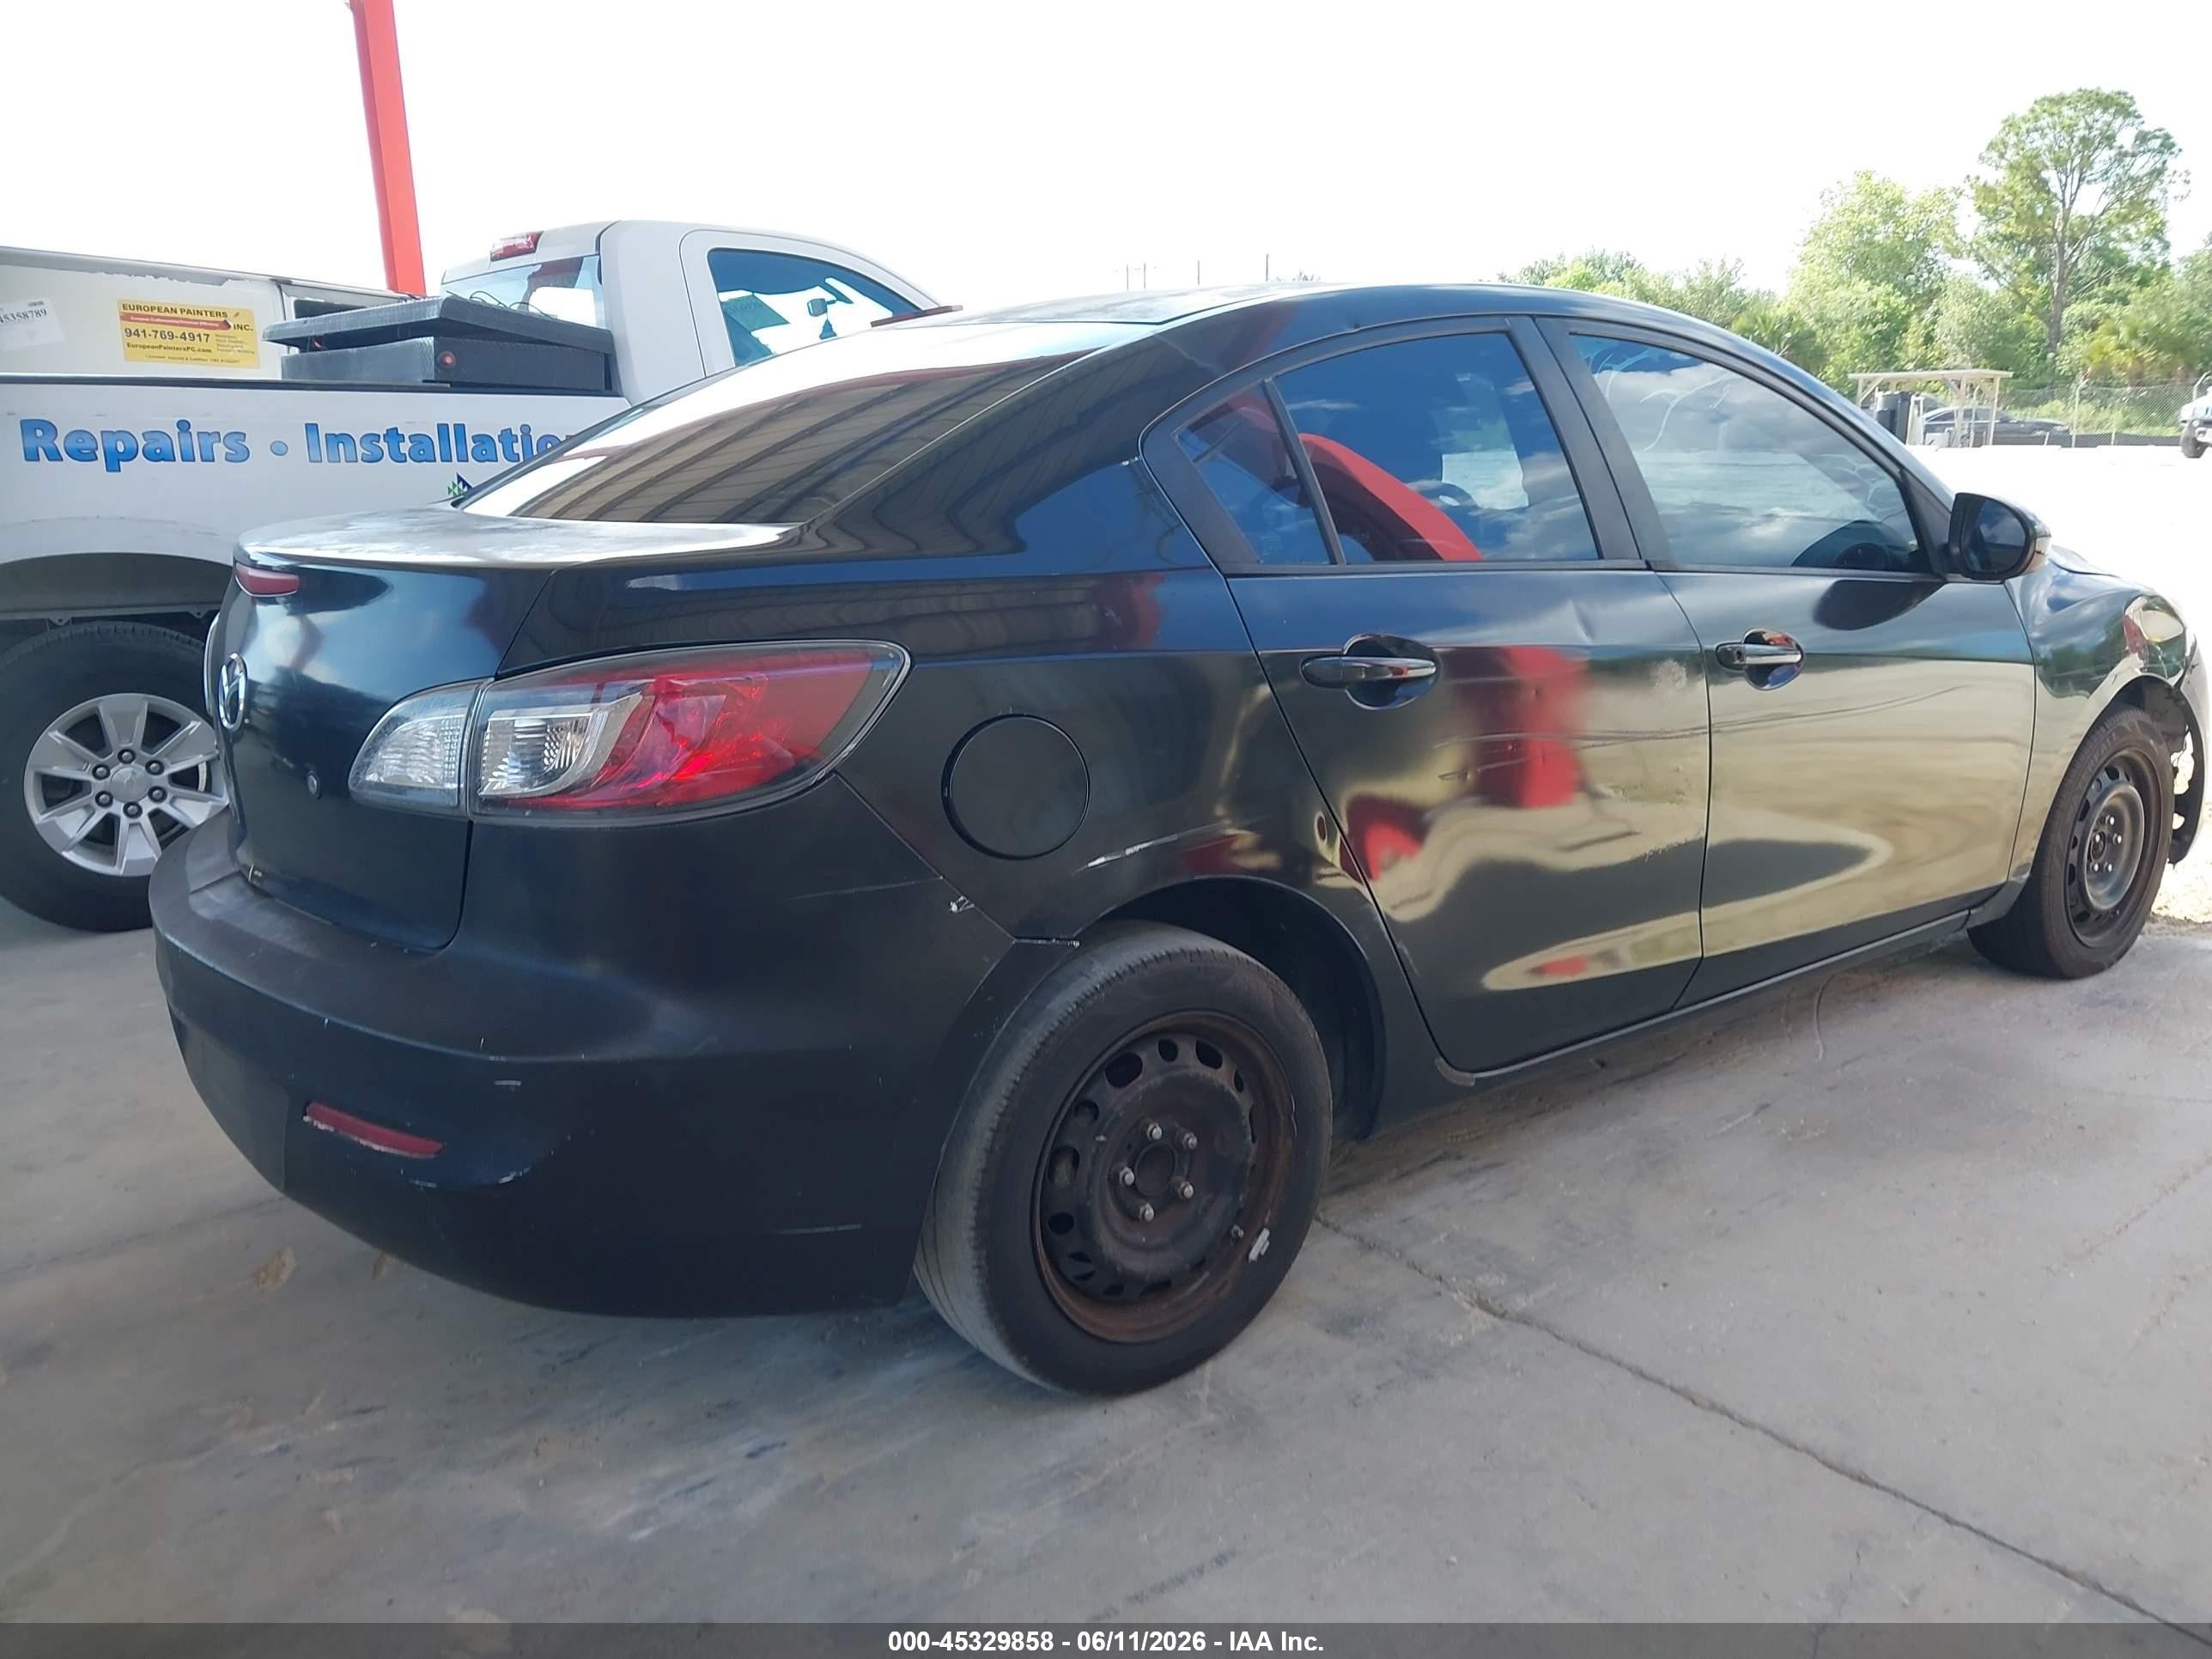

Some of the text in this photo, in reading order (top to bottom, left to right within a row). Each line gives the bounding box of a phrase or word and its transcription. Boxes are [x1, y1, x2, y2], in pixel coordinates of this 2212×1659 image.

[122, 303, 228, 318] EUROPEAN PAINTERS
[233, 323, 253, 331] INC.
[125, 327, 210, 343] 941-769-4917
[19, 418, 574, 472] Repairs Installatio
